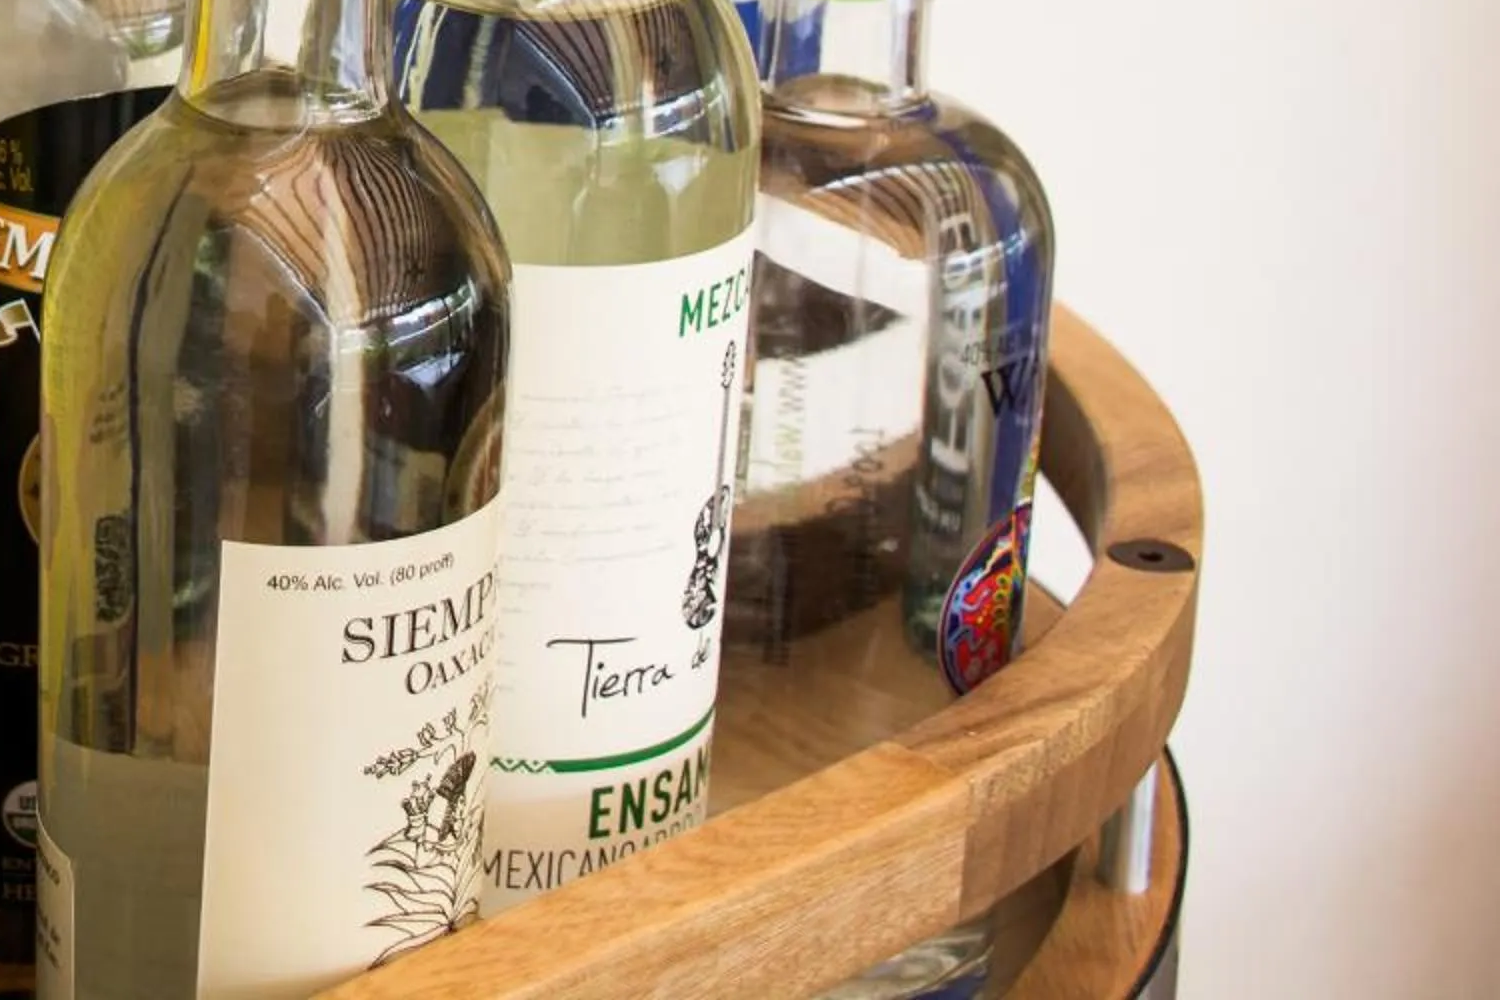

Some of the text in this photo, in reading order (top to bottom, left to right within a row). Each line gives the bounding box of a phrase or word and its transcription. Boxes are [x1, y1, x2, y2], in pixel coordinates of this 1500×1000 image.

[679, 268, 748, 338] MEZC
[266, 575, 308, 591] 40%
[341, 570, 497, 664] SIEMP
[546, 636, 675, 719] Tierra
